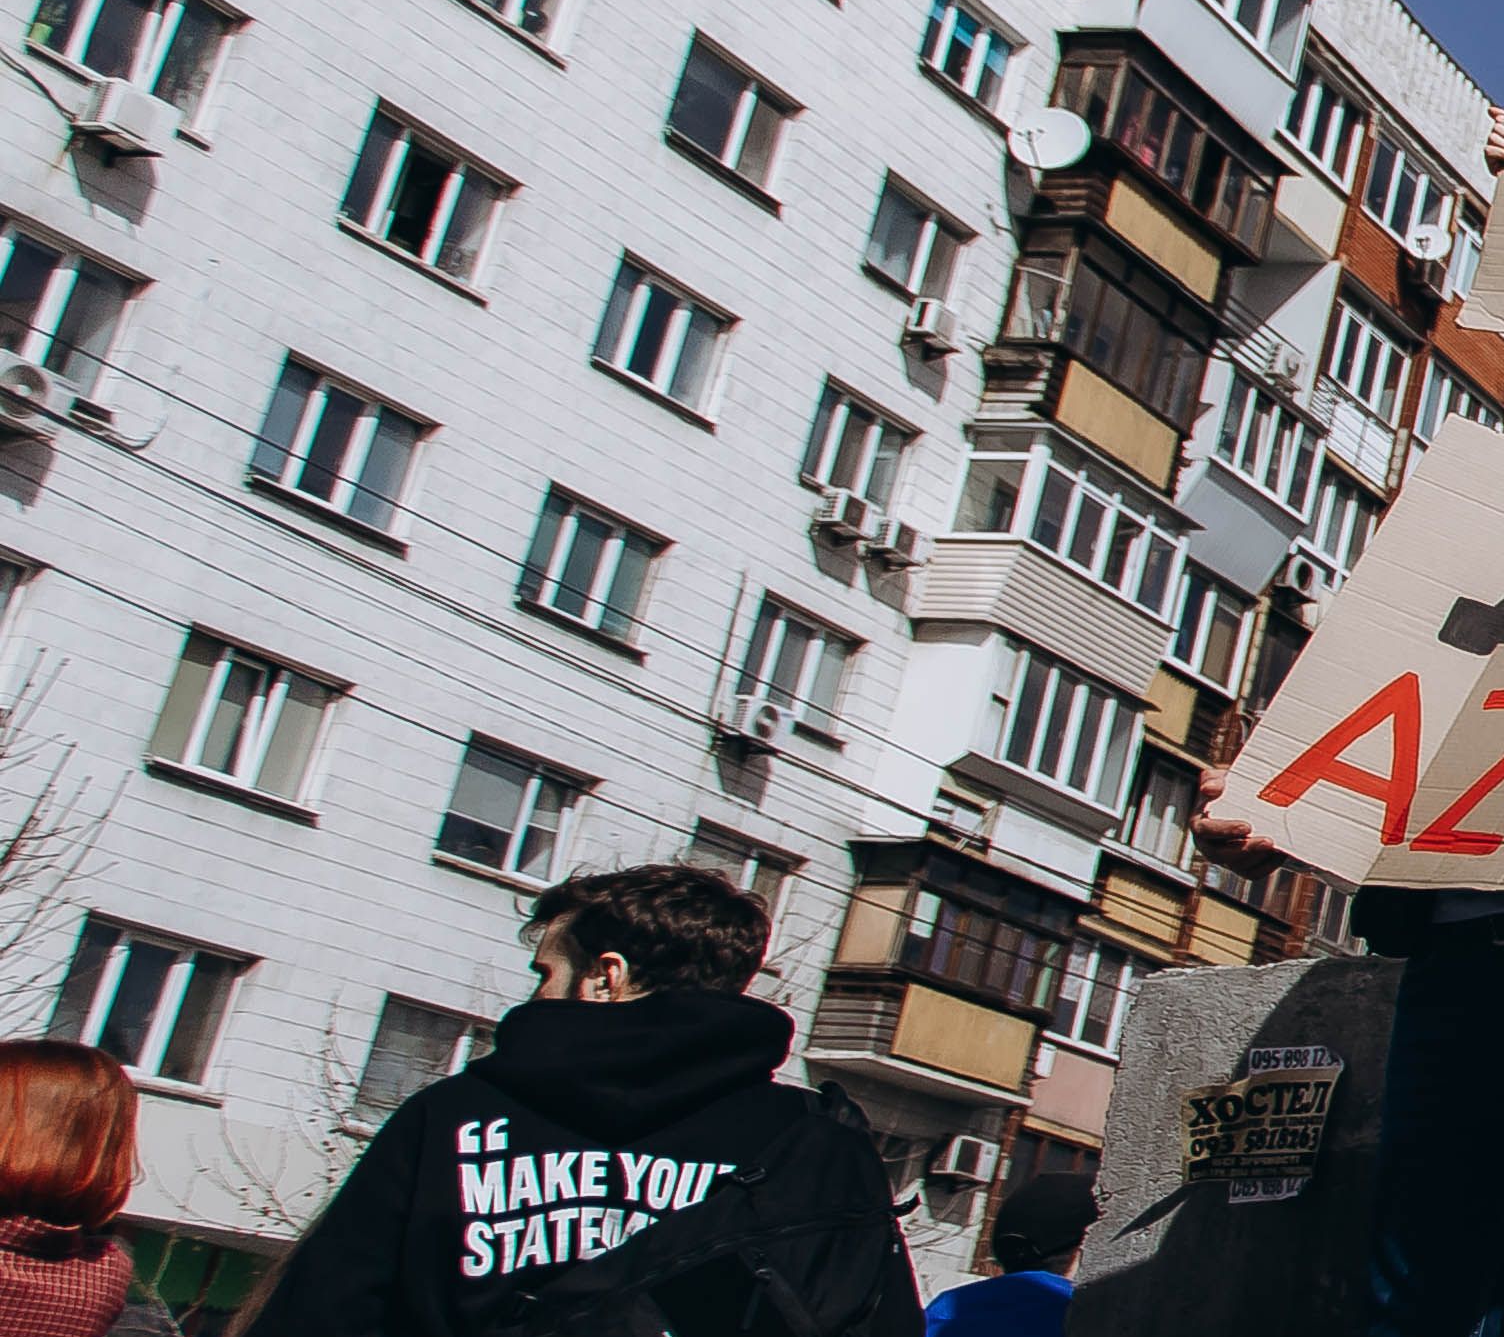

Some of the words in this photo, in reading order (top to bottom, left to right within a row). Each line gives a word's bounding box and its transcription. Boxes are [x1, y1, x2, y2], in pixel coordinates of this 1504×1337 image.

[1189, 1080, 1334, 1129] ХОСТЕЛ
[1189, 1133, 1236, 1158] 093
[458, 1150, 610, 1214] MAKE
[616, 1151, 738, 1211] YOU
